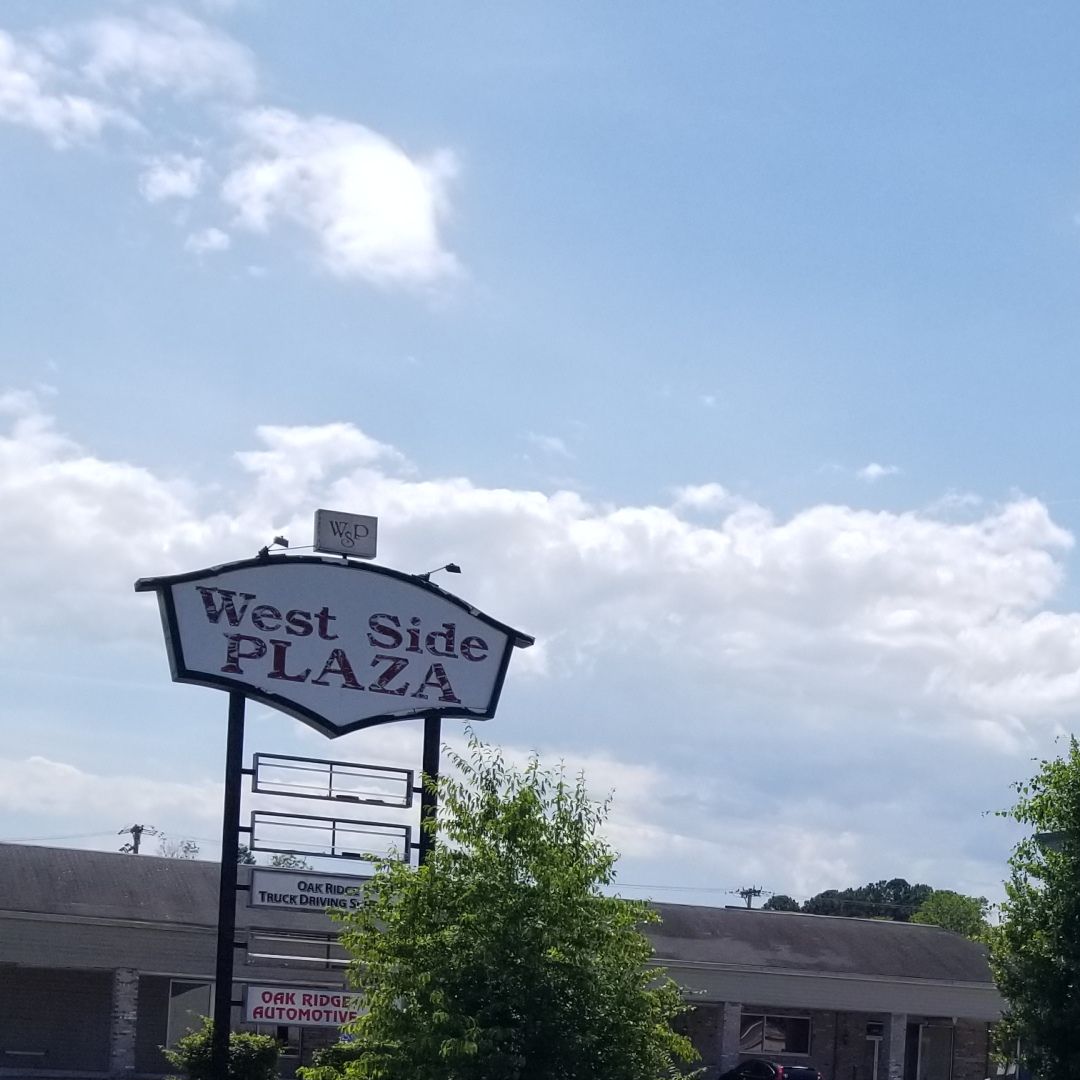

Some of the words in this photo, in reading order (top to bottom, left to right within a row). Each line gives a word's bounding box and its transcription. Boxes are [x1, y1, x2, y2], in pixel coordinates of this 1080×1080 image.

[196, 586, 338, 641] West
[367, 613, 489, 662] Side
[220, 632, 461, 703] PLAZA
[297, 881, 323, 893] OAK
[259, 891, 298, 905] TRUCK
[300, 894, 347, 908] DRIVING
[261, 991, 296, 1005] OAK
[302, 993, 351, 1008] RIDGE
[252, 1006, 358, 1023] AUTOMOTIVE
